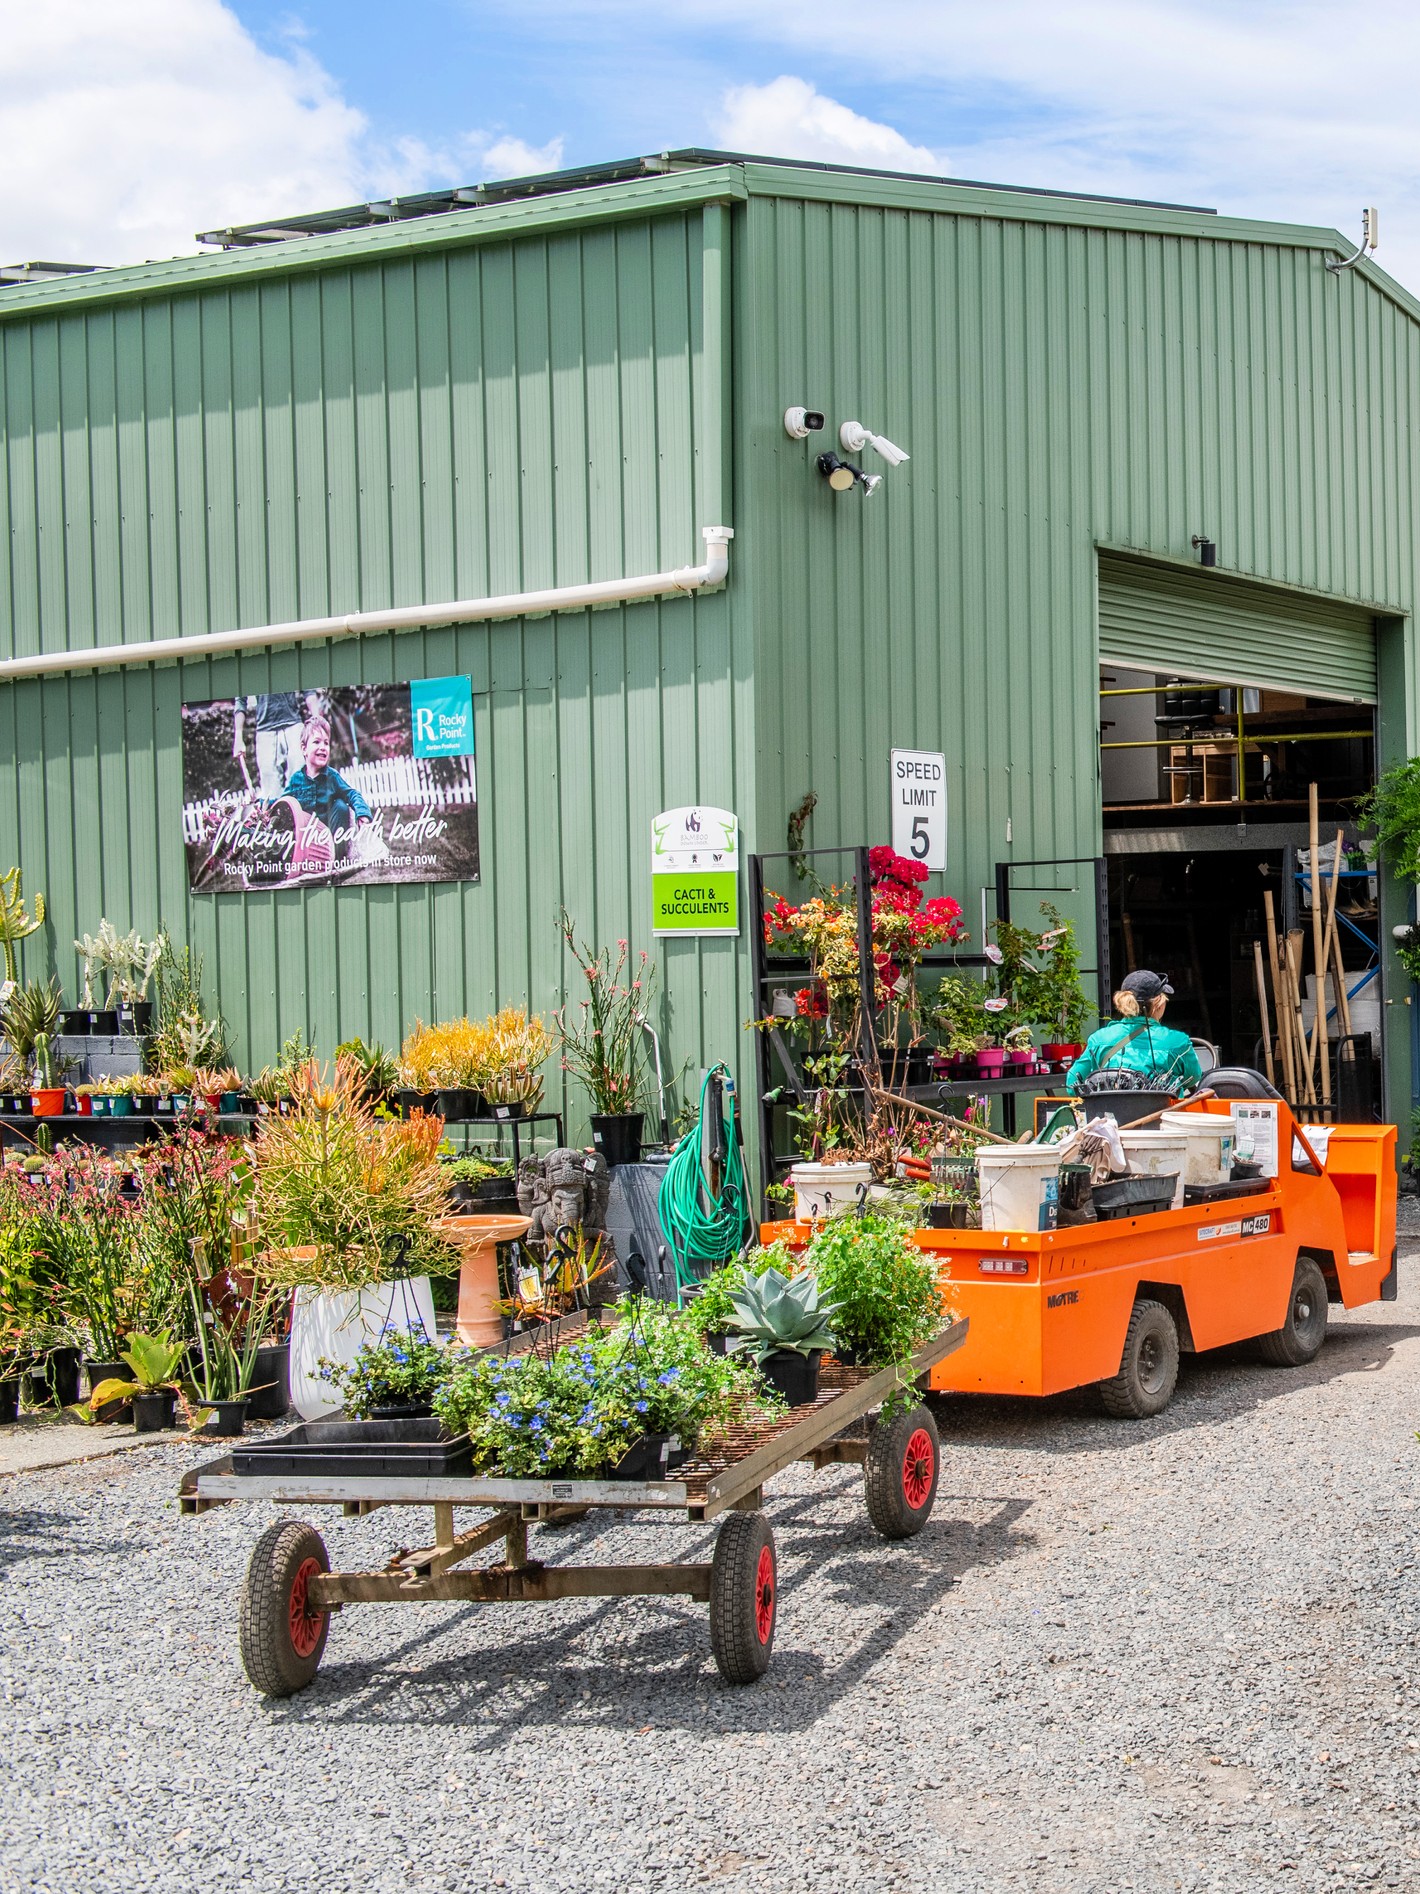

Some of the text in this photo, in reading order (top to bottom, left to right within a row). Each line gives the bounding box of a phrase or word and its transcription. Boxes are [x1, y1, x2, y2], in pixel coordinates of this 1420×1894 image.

[416, 708, 436, 742] R
[439, 713, 467, 727] Rocky
[439, 727, 462, 739] Point
[896, 761, 941, 780] SPEED
[902, 788, 936, 807] LIMIT
[212, 804, 448, 859] Making the earth better
[680, 833, 709, 842] BAMBOO
[910, 816, 930, 859] 5
[224, 854, 437, 877] Rocky Point garden products in store now
[674, 888, 716, 901] CACTI &
[661, 902, 730, 915] SUCCULENTS
